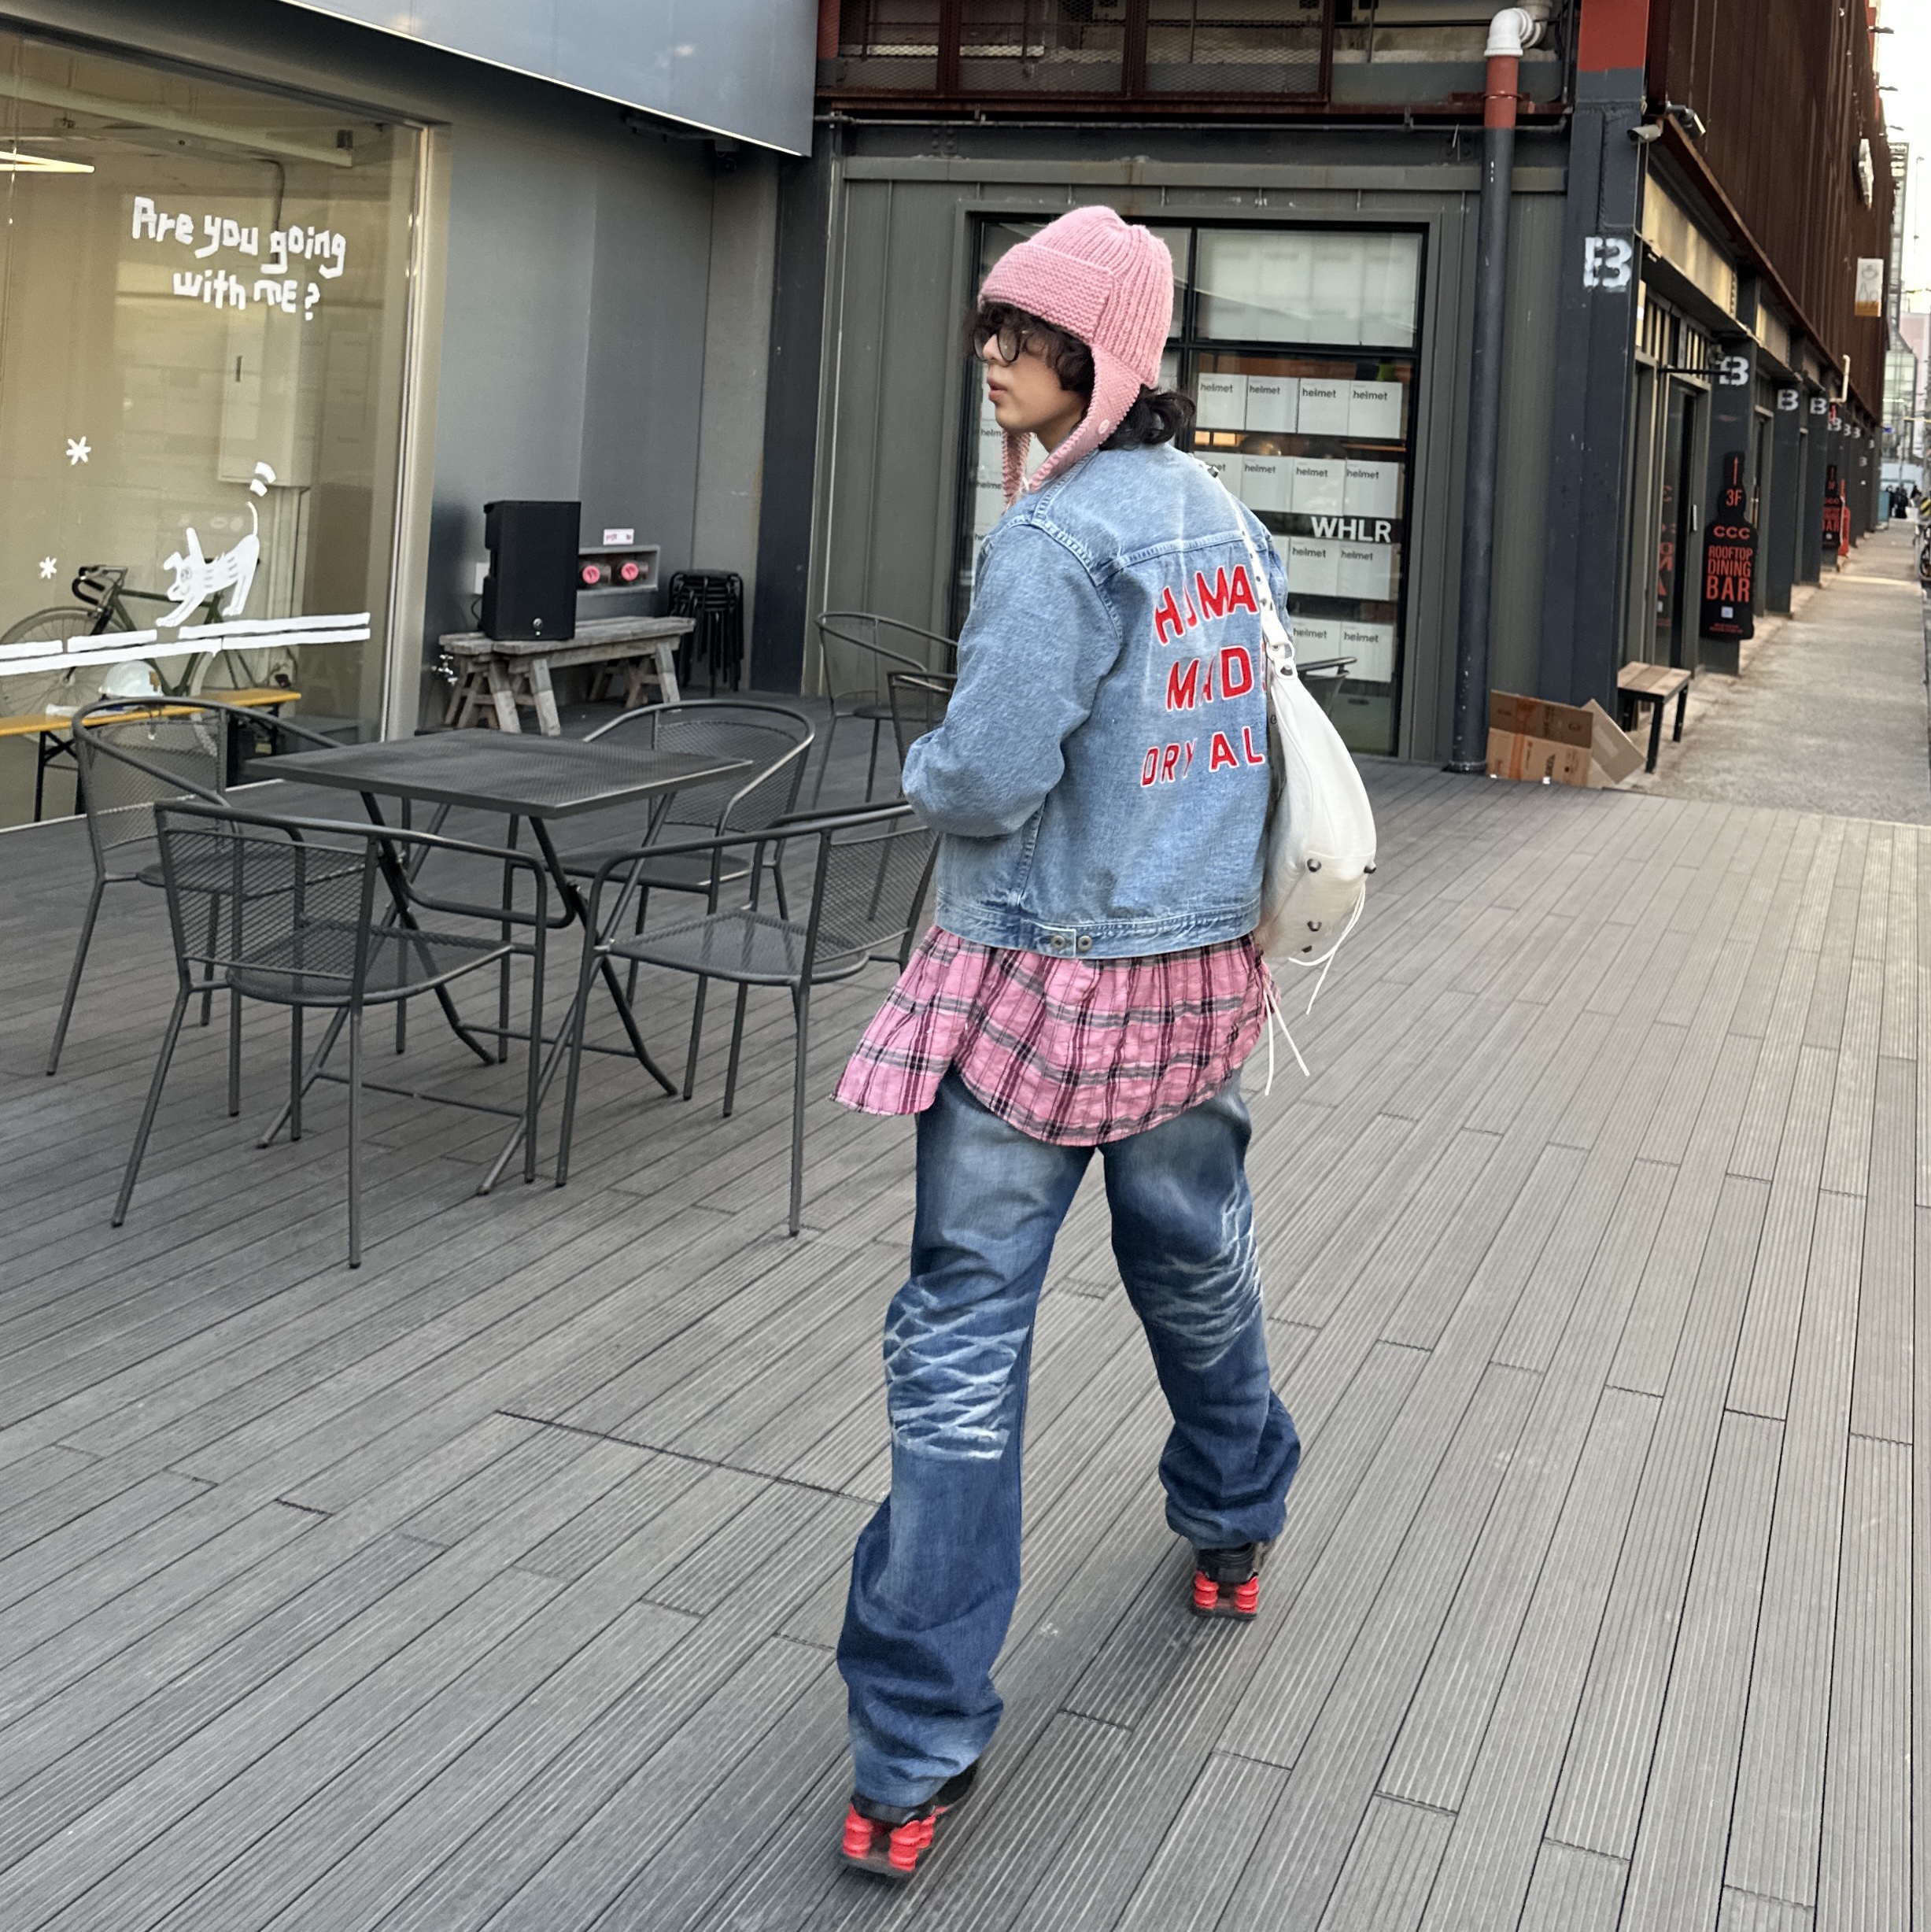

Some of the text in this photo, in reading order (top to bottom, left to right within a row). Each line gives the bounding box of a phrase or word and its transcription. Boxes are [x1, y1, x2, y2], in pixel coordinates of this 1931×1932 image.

[132, 197, 346, 279] Are you going
[173, 270, 246, 310] with
[1719, 356, 1749, 386] B
[1200, 383, 1233, 393] helmet
[1249, 385, 1281, 395] helmet
[1302, 387, 1337, 398] helmet
[1353, 390, 1387, 401] helmet
[1777, 389, 1799, 411] B
[1810, 397, 1827, 415] B
[1244, 464, 1276, 474] helmet
[1296, 466, 1328, 478] helmet
[1346, 470, 1379, 480] helmet
[977, 481, 1002, 489] helme
[1726, 489, 1743, 506] 3F
[1311, 516, 1392, 543] WHLR
[1713, 525, 1751, 540] CCC
[1292, 547, 1326, 558] helmet
[1341, 550, 1373, 561] helmet
[1708, 545, 1753, 560] ROOFTOP
[1708, 558, 1752, 578] DINING
[1706, 575, 1750, 603] BAR
[1293, 627, 1327, 639] helmet
[1343, 631, 1379, 643] helmet
